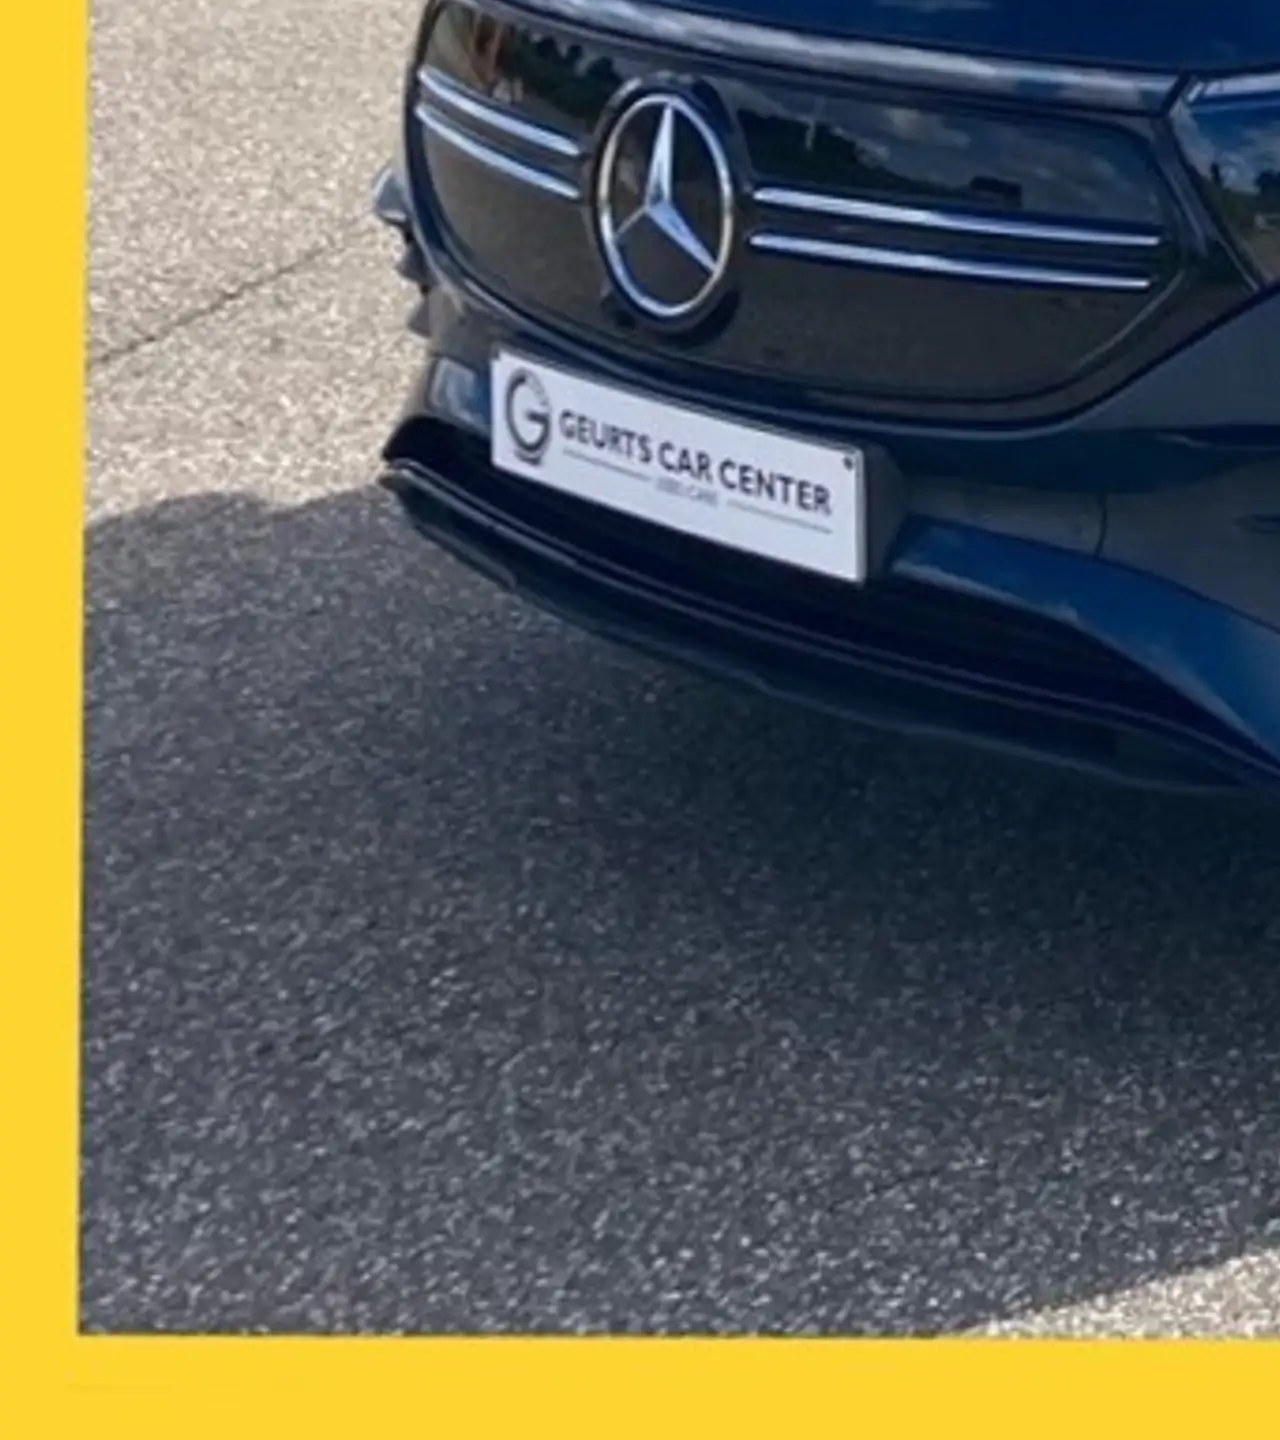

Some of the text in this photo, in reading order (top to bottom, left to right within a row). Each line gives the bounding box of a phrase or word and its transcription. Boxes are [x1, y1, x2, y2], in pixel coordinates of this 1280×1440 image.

[558, 409, 834, 517] GEURTS CAR CENTER
